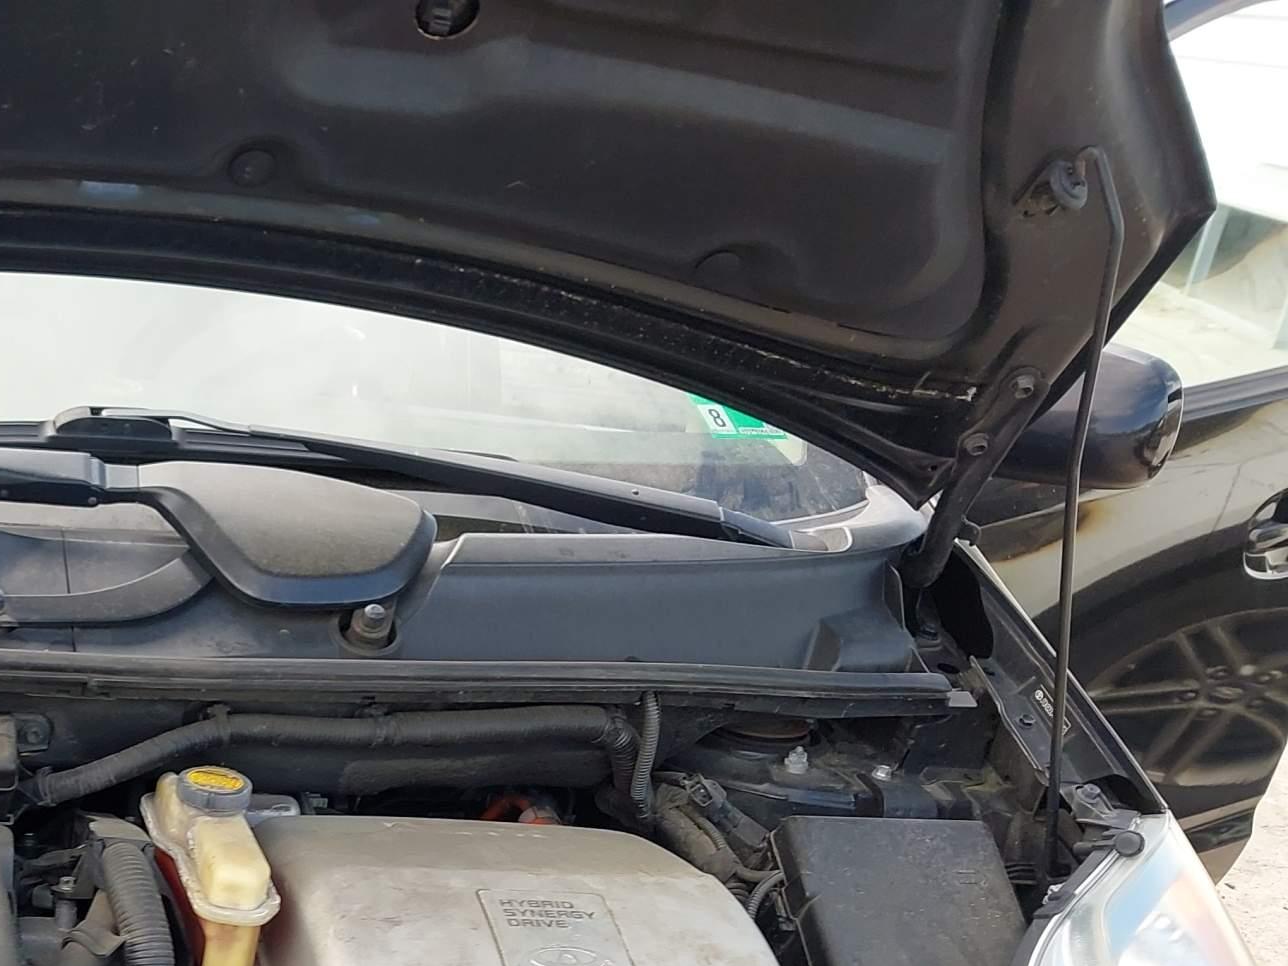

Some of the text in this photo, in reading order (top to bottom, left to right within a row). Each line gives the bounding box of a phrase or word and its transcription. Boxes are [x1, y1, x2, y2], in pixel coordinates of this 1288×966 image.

[709, 409, 726, 428] 8
[500, 899, 575, 909] HYBRID
[504, 909, 595, 919] SYNERGY
[509, 919, 569, 928] DRIVE
